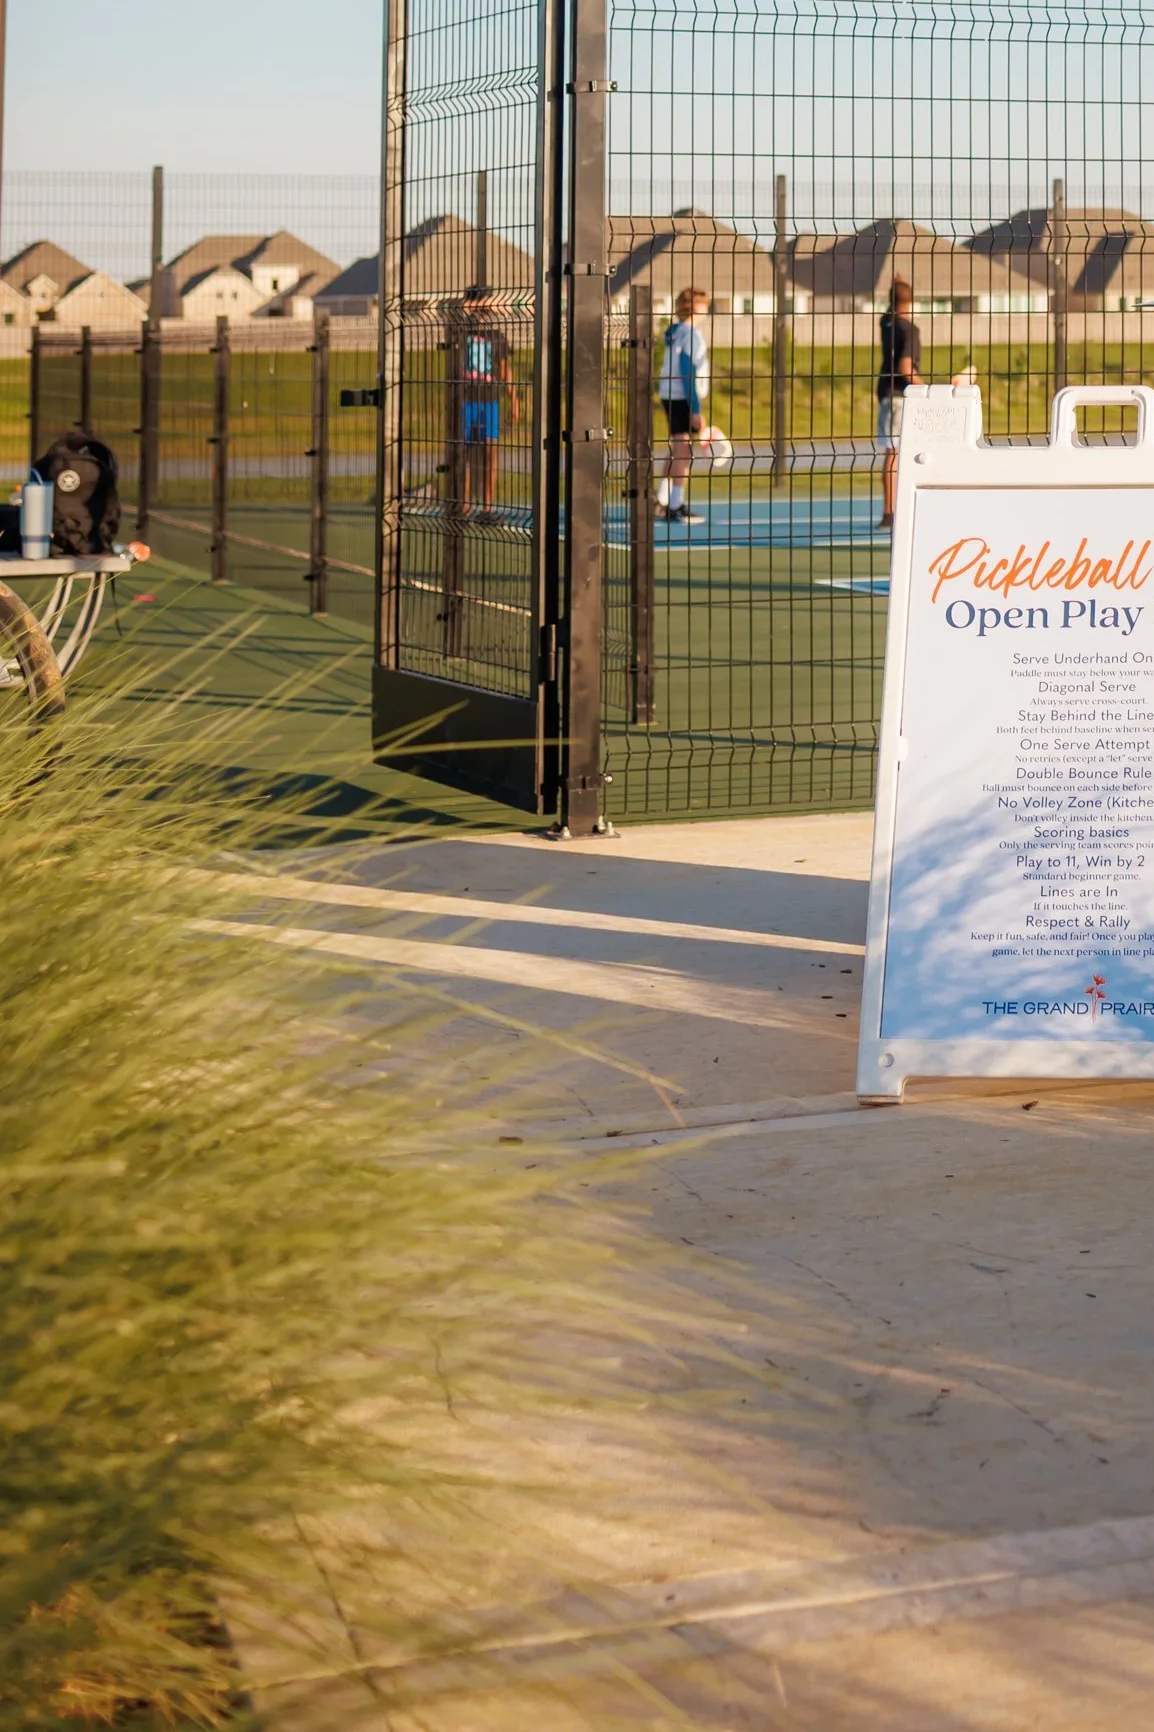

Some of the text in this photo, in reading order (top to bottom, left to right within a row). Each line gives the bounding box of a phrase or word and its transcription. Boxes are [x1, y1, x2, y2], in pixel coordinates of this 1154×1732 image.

[929, 537, 1153, 604] Pickleball
[946, 600, 1049, 637] Open
[1060, 599, 1144, 636] Play
[1013, 653, 1049, 665] Serve
[1054, 653, 1127, 664] Underhand
[1069, 670, 1087, 678] stay
[1119, 670, 1141, 678] your
[1039, 681, 1136, 695] Diagonal Serve
[1030, 698, 1063, 706] Always
[1018, 710, 1154, 724] Stay Behind the Line
[996, 726, 1018, 734] Both
[1021, 726, 1038, 734] feet
[1040, 726, 1072, 734] behind
[1020, 739, 1150, 752] One Serve Attempt
[1015, 755, 1027, 763] No
[1063, 755, 1097, 763] (except
[1016, 767, 1152, 779] Double Bounce Rule
[998, 797, 1017, 808] No
[1023, 797, 1063, 810] Volley
[1068, 797, 1102, 808] Zone
[1041, 815, 1067, 823] volley
[1070, 814, 1098, 822] inside
[1034, 826, 1129, 840] Scoring basics
[999, 841, 1021, 850] Only
[1040, 842, 1075, 850] serving
[1016, 855, 1144, 869] Play to 11, Win by 2
[1069, 873, 1112, 882] beginner
[1040, 886, 1117, 897] Lines are In
[1026, 916, 1131, 929] Respect & Rally
[970, 933, 995, 942] Keep
[1006, 933, 1024, 941] fun,
[1026, 932, 1048, 941] safe,
[1050, 932, 1068, 940] and
[1070, 932, 1090, 940] fair!
[1092, 932, 1116, 940] Once
[992, 949, 1020, 957] game,
[1076, 949, 1110, 957] person
[982, 1002, 1018, 1014] THE
[1023, 1002, 1088, 1014] GRAND
